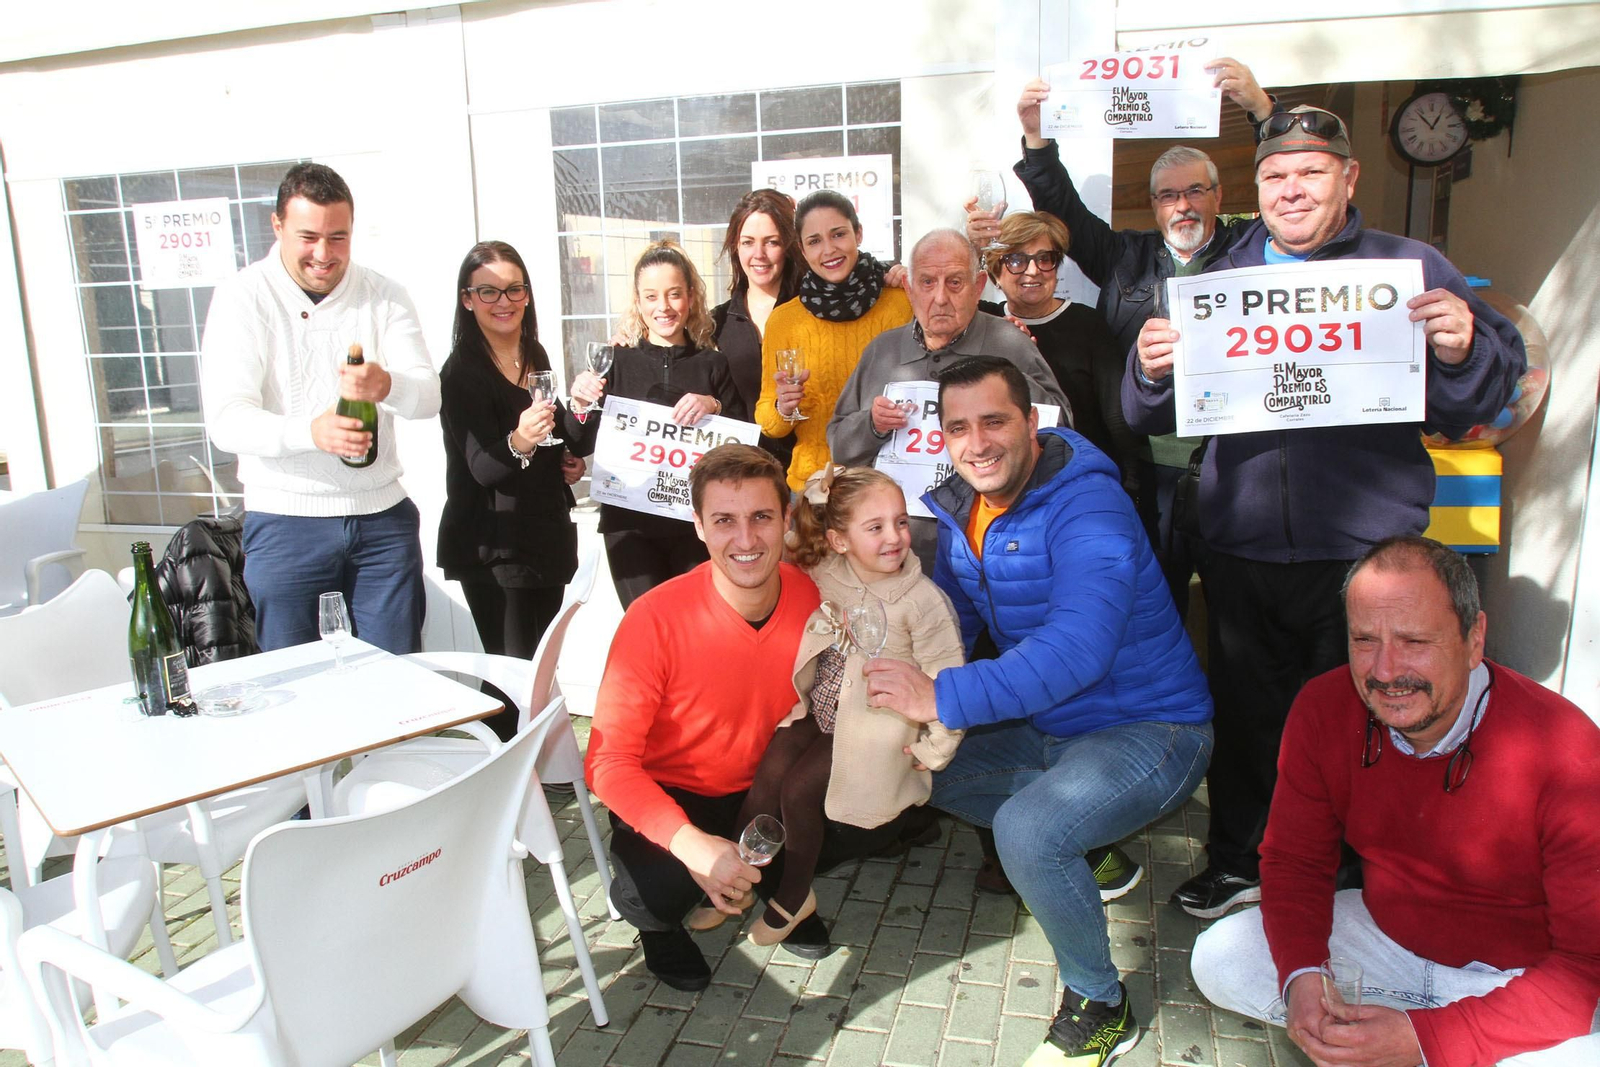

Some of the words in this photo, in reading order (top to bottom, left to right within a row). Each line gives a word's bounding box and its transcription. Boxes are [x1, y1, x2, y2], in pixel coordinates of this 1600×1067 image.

[1079, 54, 1180, 80] 29031
[1112, 86, 1120, 95] EL
[1121, 86, 1148, 103] MAYOR
[1112, 95, 1140, 113] PREMIO
[1141, 101, 1151, 113] ES
[1104, 109, 1153, 125] COMPARTIRLO
[794, 170, 878, 191] PREMIO
[163, 211, 221, 228] PREMIO
[159, 231, 211, 249] 29031
[1193, 292, 1227, 321] 5º
[1242, 282, 1399, 316] PREMIO
[1226, 321, 1362, 358] 29031
[1273, 363, 1284, 373] EL
[1285, 361, 1323, 383] MAYOR
[1273, 374, 1312, 396] PREMIO
[1314, 378, 1328, 393] ES
[1263, 392, 1331, 412] COMPARTIRLO
[614, 413, 638, 431] 5º
[936, 462, 945, 471] EL
[656, 477, 680, 495] PREMIO
[681, 488, 690, 498] ES
[658, 470, 665, 478] EL
[665, 471, 689, 488] MAYOR
[647, 487, 691, 506] COMPARTIRLO
[379, 847, 442, 887] Cruzcampo
